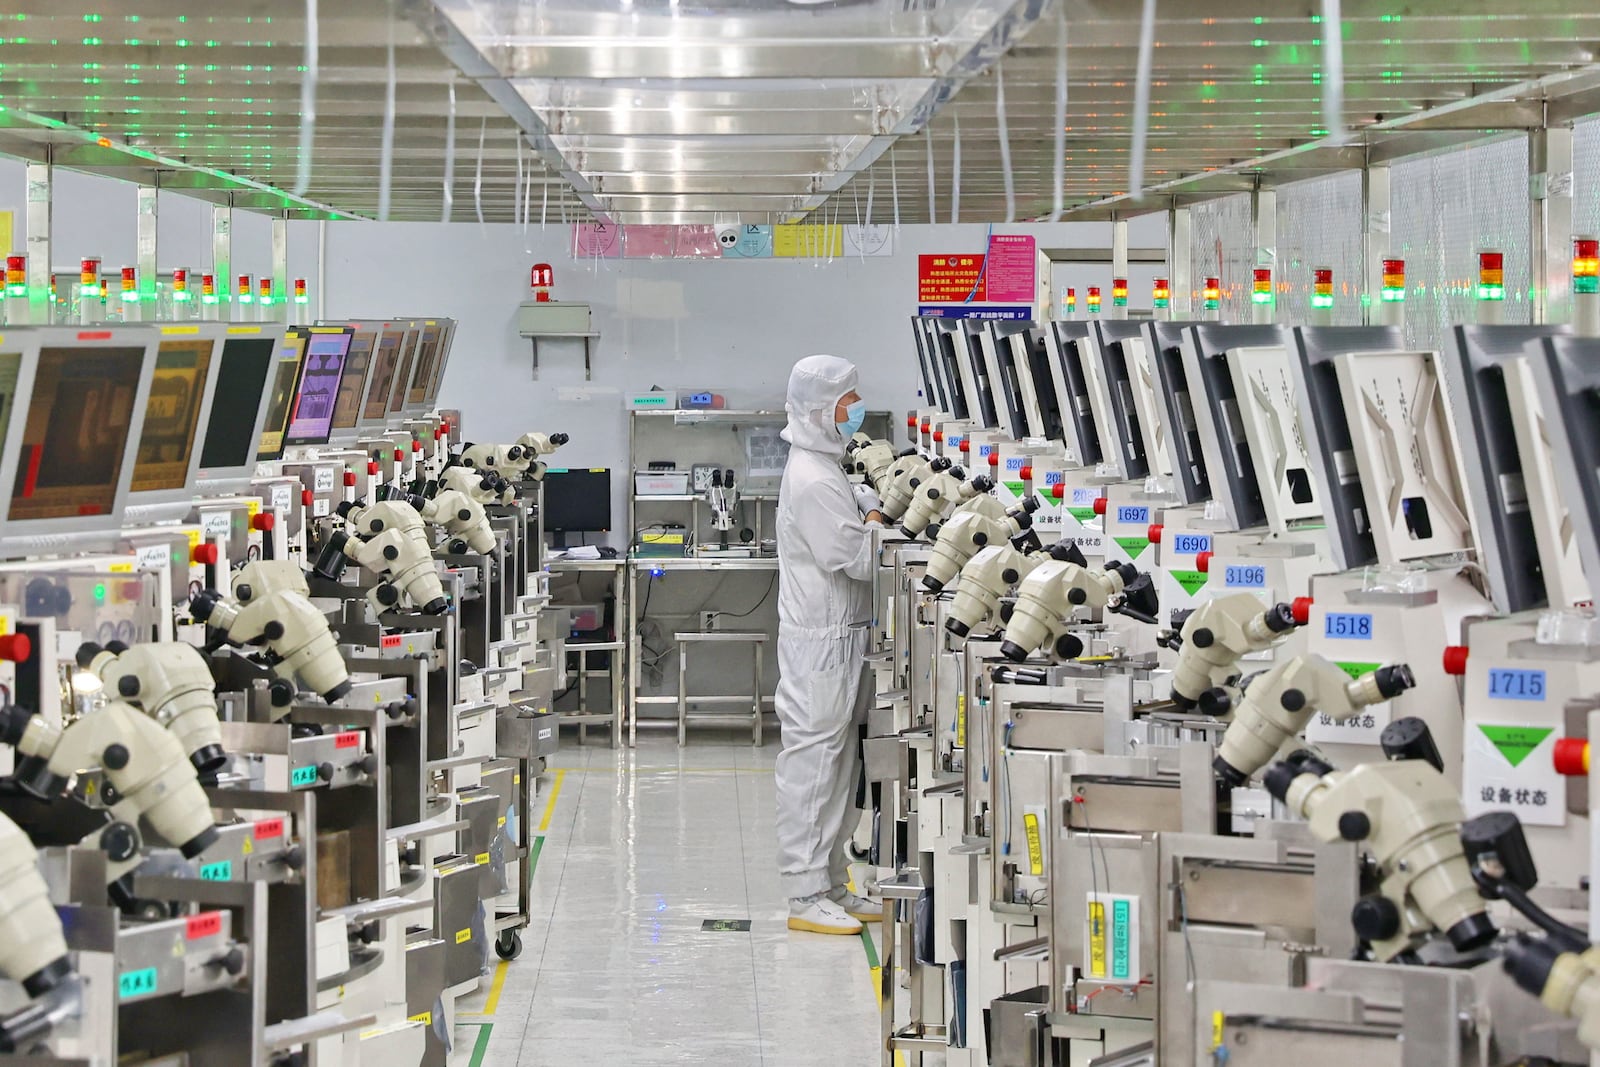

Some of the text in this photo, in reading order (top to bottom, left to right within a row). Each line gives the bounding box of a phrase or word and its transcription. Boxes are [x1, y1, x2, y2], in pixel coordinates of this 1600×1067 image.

[1118, 508, 1147, 521] 1697
[1175, 537, 1208, 551] 1690
[1226, 568, 1264, 584] 3196
[1326, 616, 1369, 635] 1518
[1490, 672, 1542, 695] 1715
[1480, 786, 1548, 806] 设备状态
